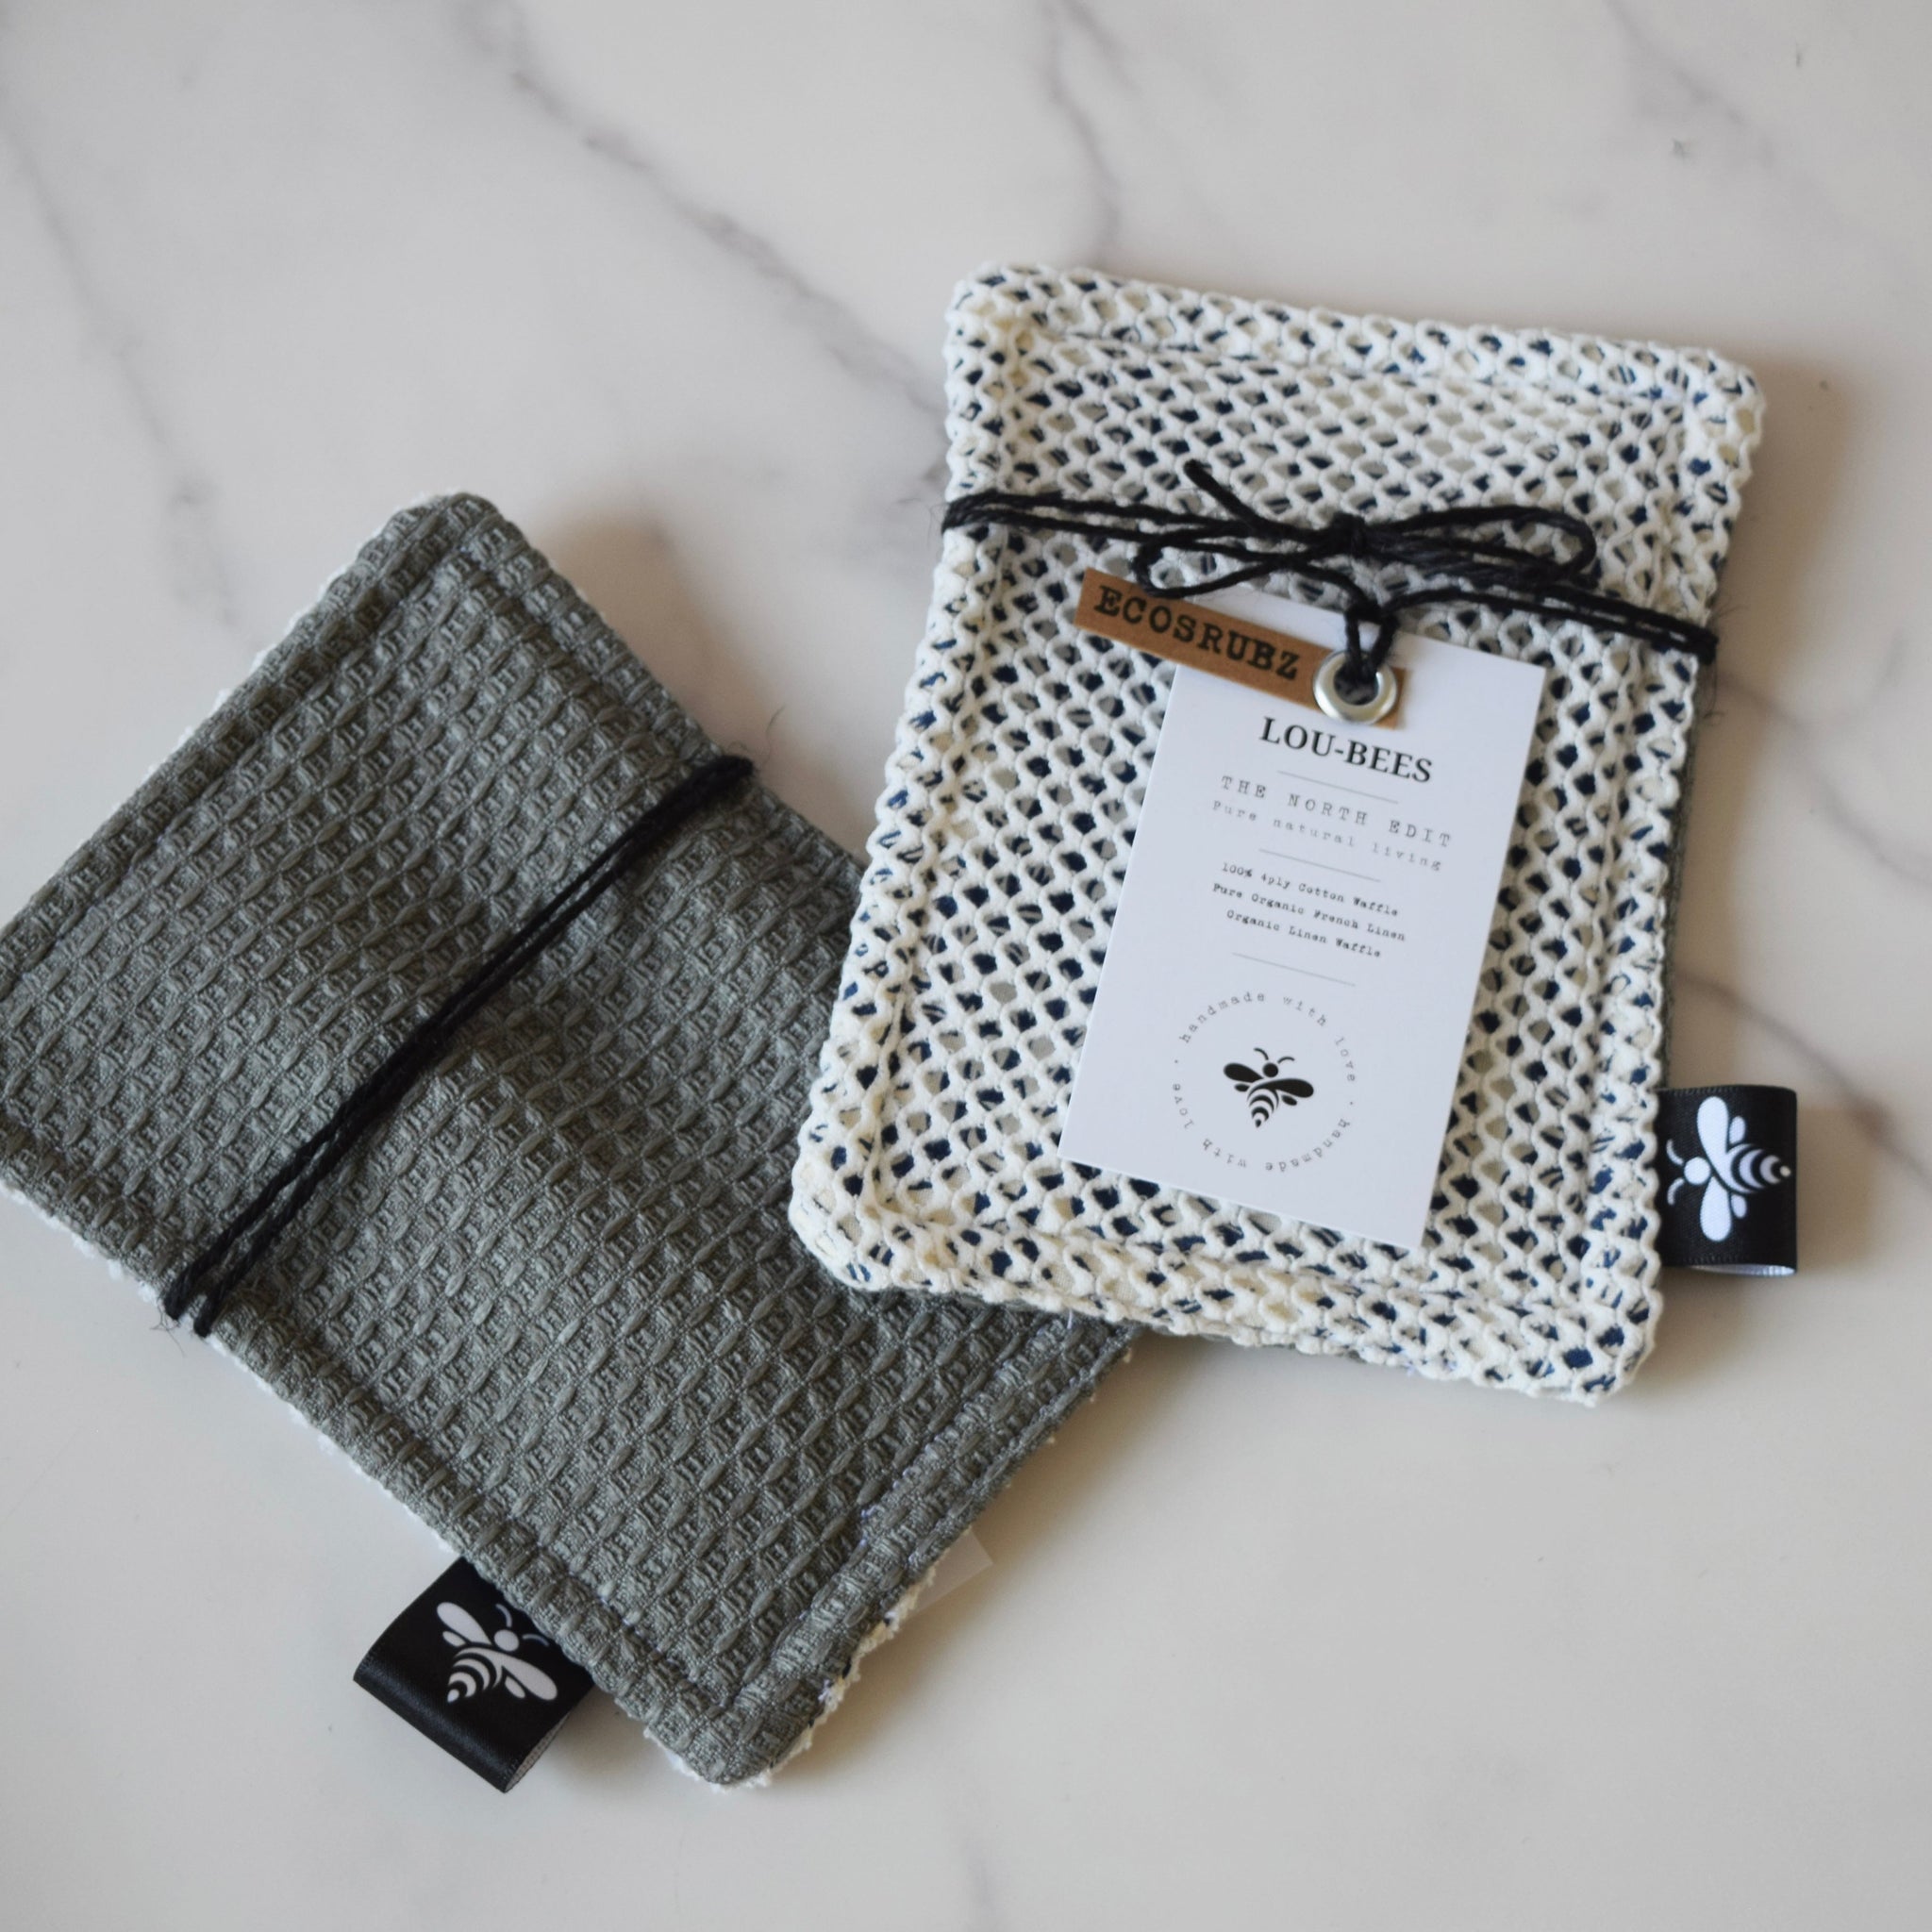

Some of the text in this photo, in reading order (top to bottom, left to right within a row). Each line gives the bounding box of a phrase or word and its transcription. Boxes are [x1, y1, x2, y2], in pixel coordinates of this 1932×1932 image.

[1093, 584, 1300, 681] ECOSRUBZ
[1259, 716, 1433, 783] LOU-BEES
[1213, 800, 1441, 871] Pure natural living
[1222, 775, 1450, 847] THE NORTH EDIT
[1213, 883, 1242, 898] Pure
[1251, 892, 1304, 914] Organic
[1367, 923, 1406, 941] Linen
[1223, 862, 1398, 916] 100% 4ply Cotton Waffle
[1226, 909, 1381, 958] Organic Linen Waffle
[1179, 991, 1356, 1082] handmade with love
[1173, 1083, 1350, 1172] handmade with love
